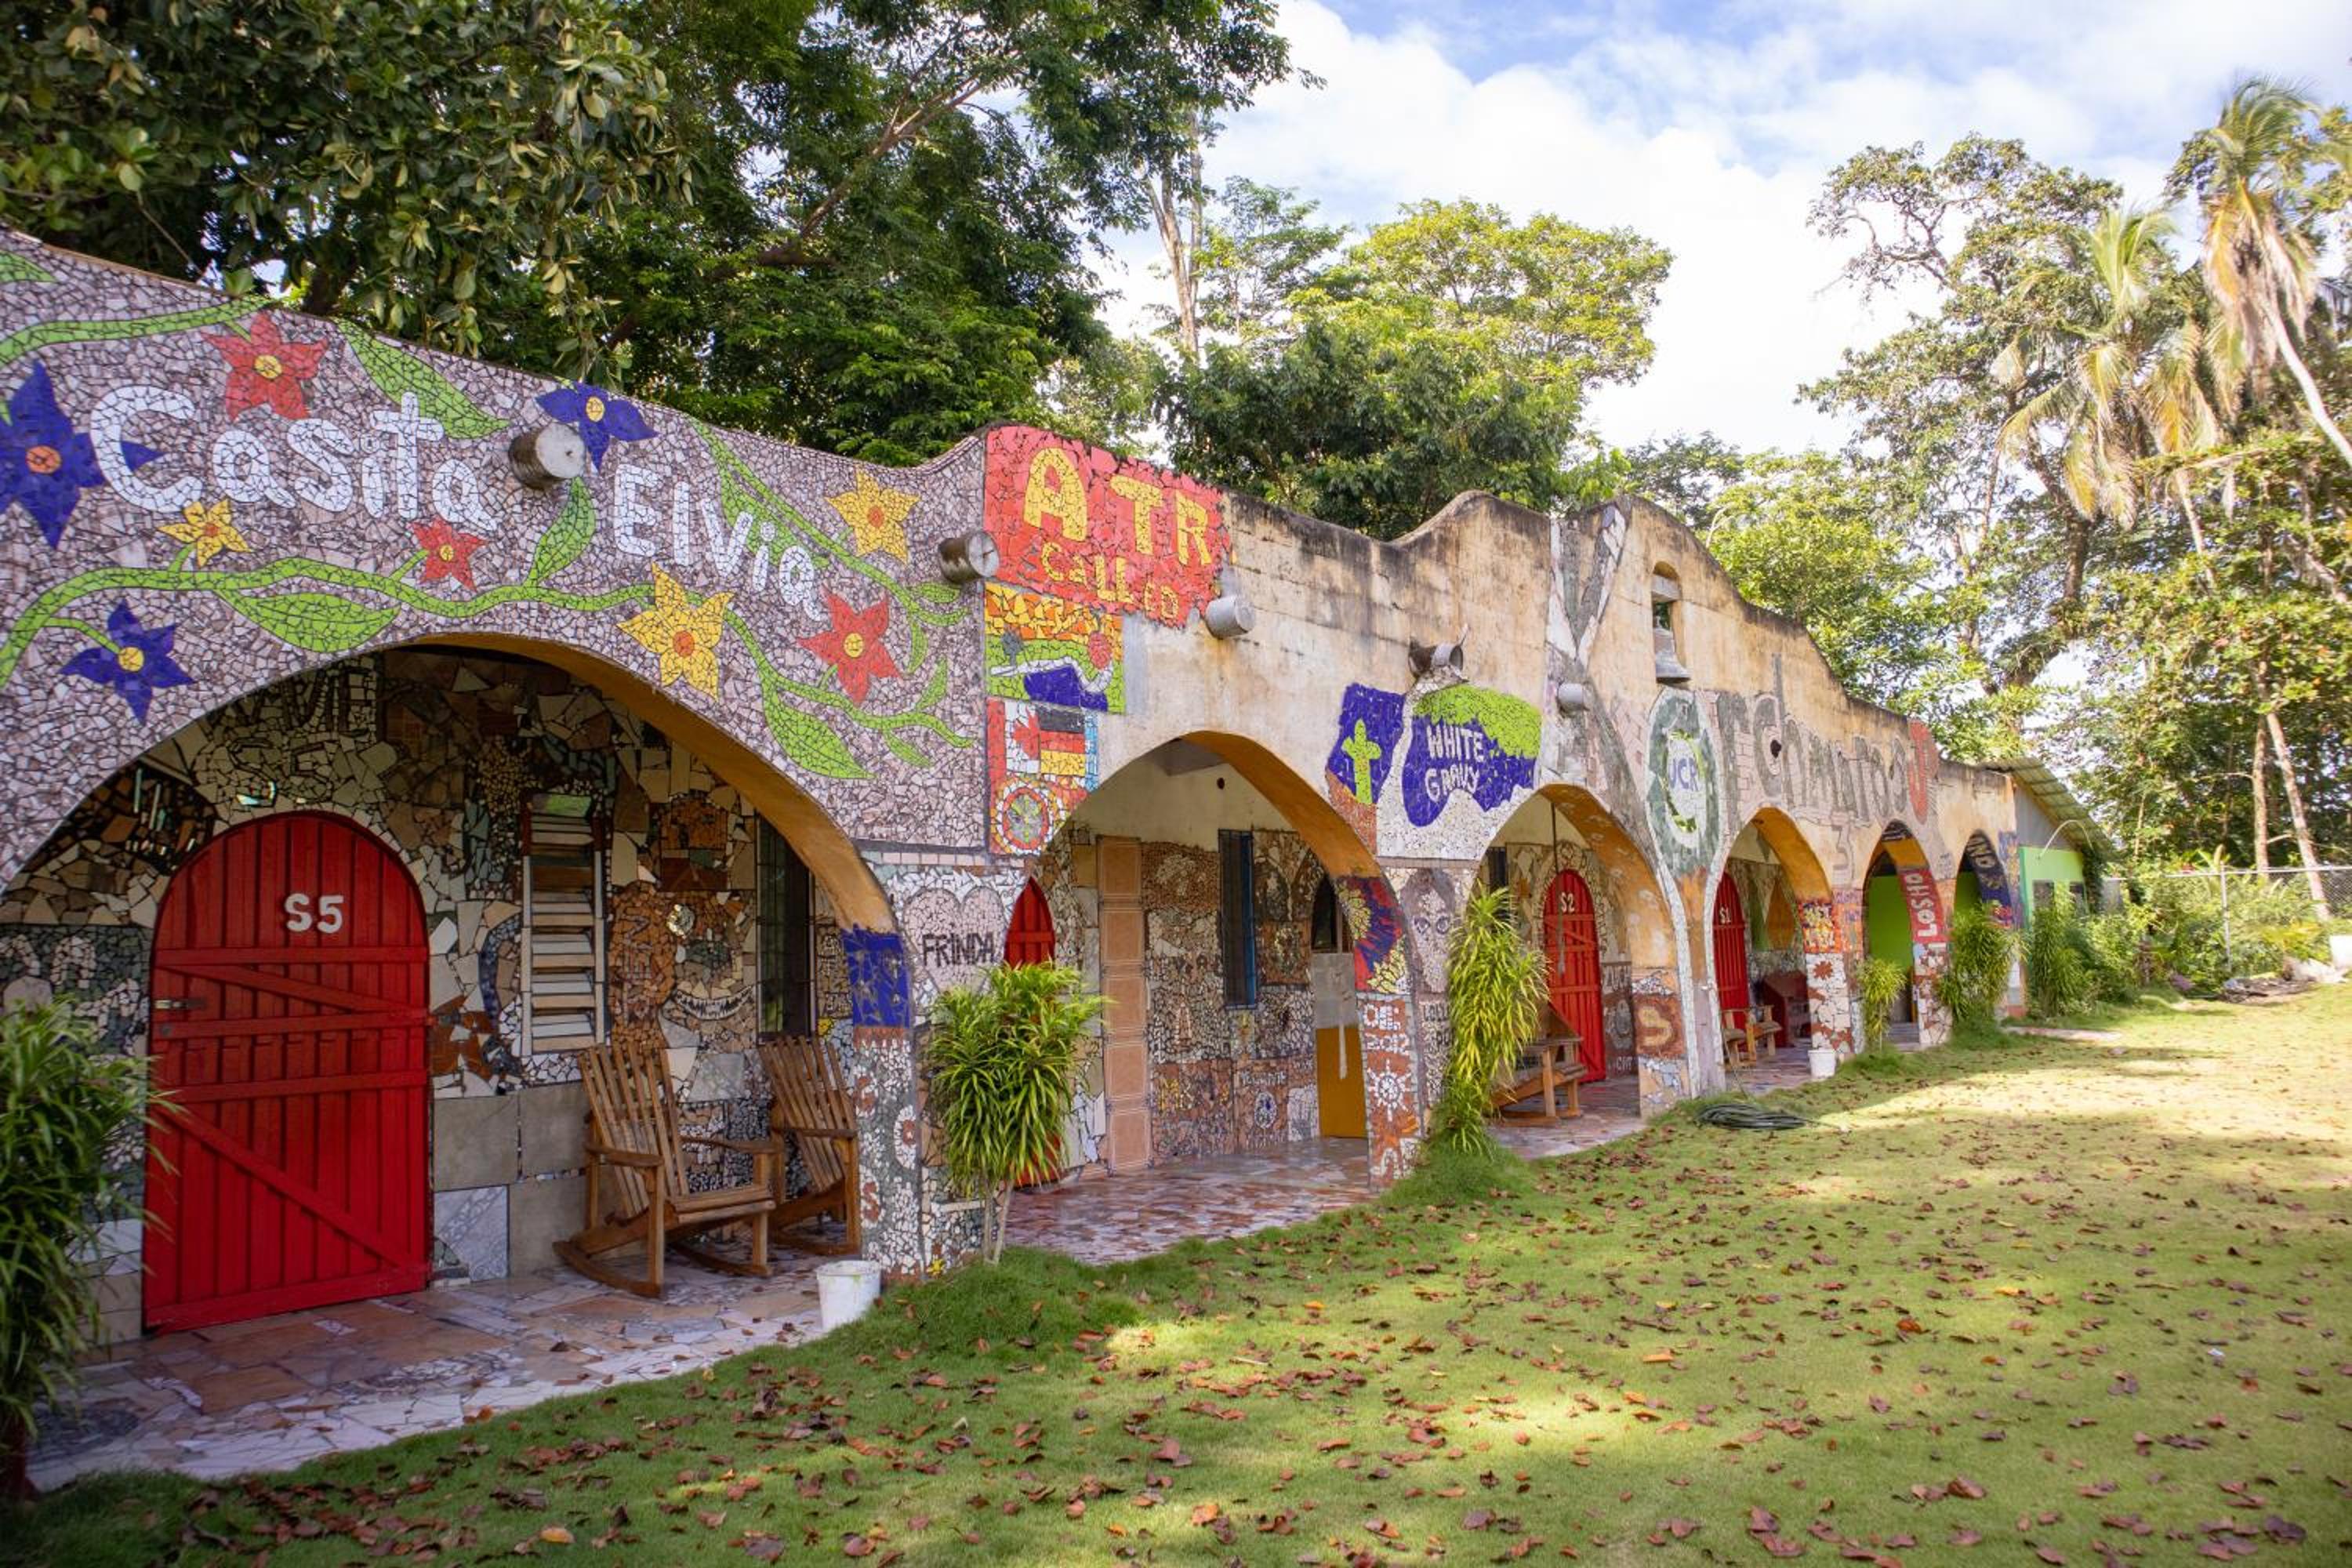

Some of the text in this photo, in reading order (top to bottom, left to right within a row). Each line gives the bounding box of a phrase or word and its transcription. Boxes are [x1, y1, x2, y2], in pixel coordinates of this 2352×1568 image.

[1426, 724, 1485, 763] WHITE
[284, 893, 344, 934] S5
[1560, 891, 1575, 913] S2
